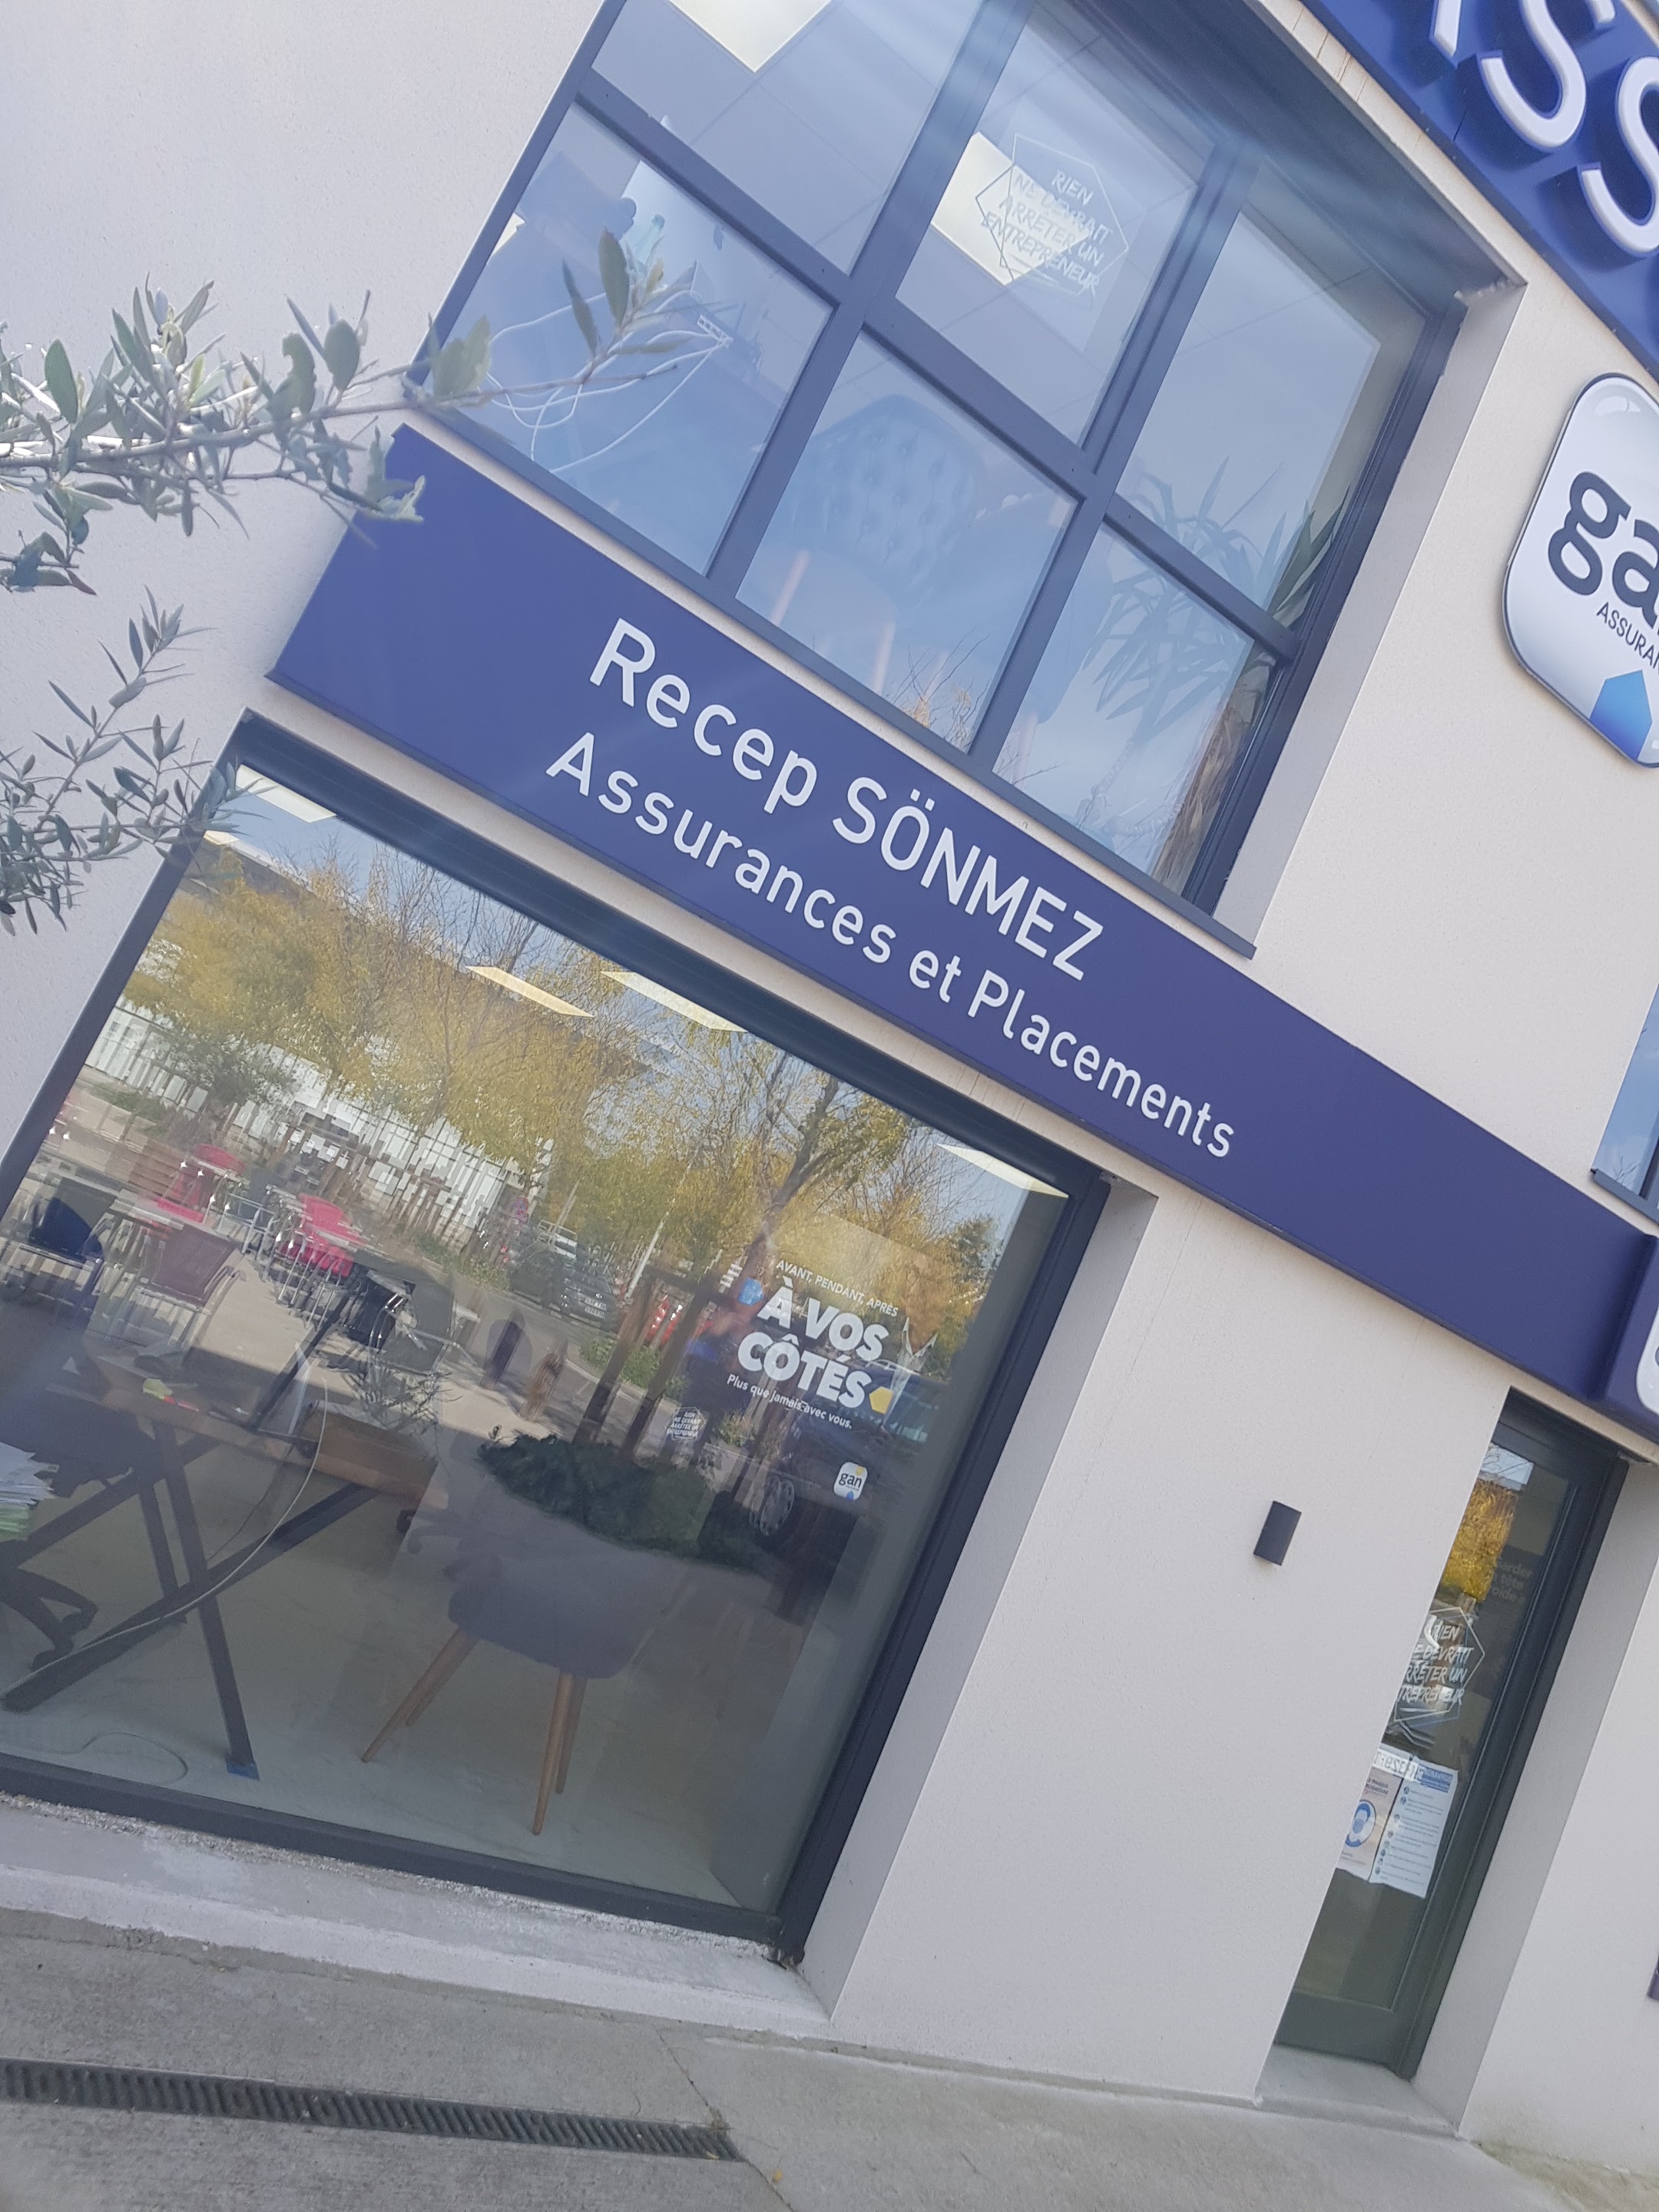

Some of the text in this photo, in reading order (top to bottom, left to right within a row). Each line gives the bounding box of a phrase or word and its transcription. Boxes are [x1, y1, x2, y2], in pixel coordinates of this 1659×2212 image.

[1434, 0, 1659, 253] SS
[1051, 169, 1094, 206] RIEN
[1078, 242, 1104, 267] UN
[1548, 471, 1659, 636] ga
[1597, 601, 1659, 669] ASSURA
[590, 618, 1104, 981] Recep SÖNMEZ
[546, 732, 1235, 1158] Assurances et Placements
[776, 1260, 899, 1316] AVANT, PENDANT, APRÈS
[757, 1275, 889, 1362] À VOS
[737, 1331, 873, 1409] CÔTÉS
[727, 1373, 748, 1390] Plus
[750, 1385, 770, 1399] que
[804, 1404, 827, 1419] avec
[828, 1413, 853, 1429] vous.
[839, 1473, 862, 1488] gan
[1422, 1646, 1475, 1665] DEVRAIT
[1449, 1667, 1468, 1684] UN
[1397, 1684, 1465, 1705] TREPRENEUR
